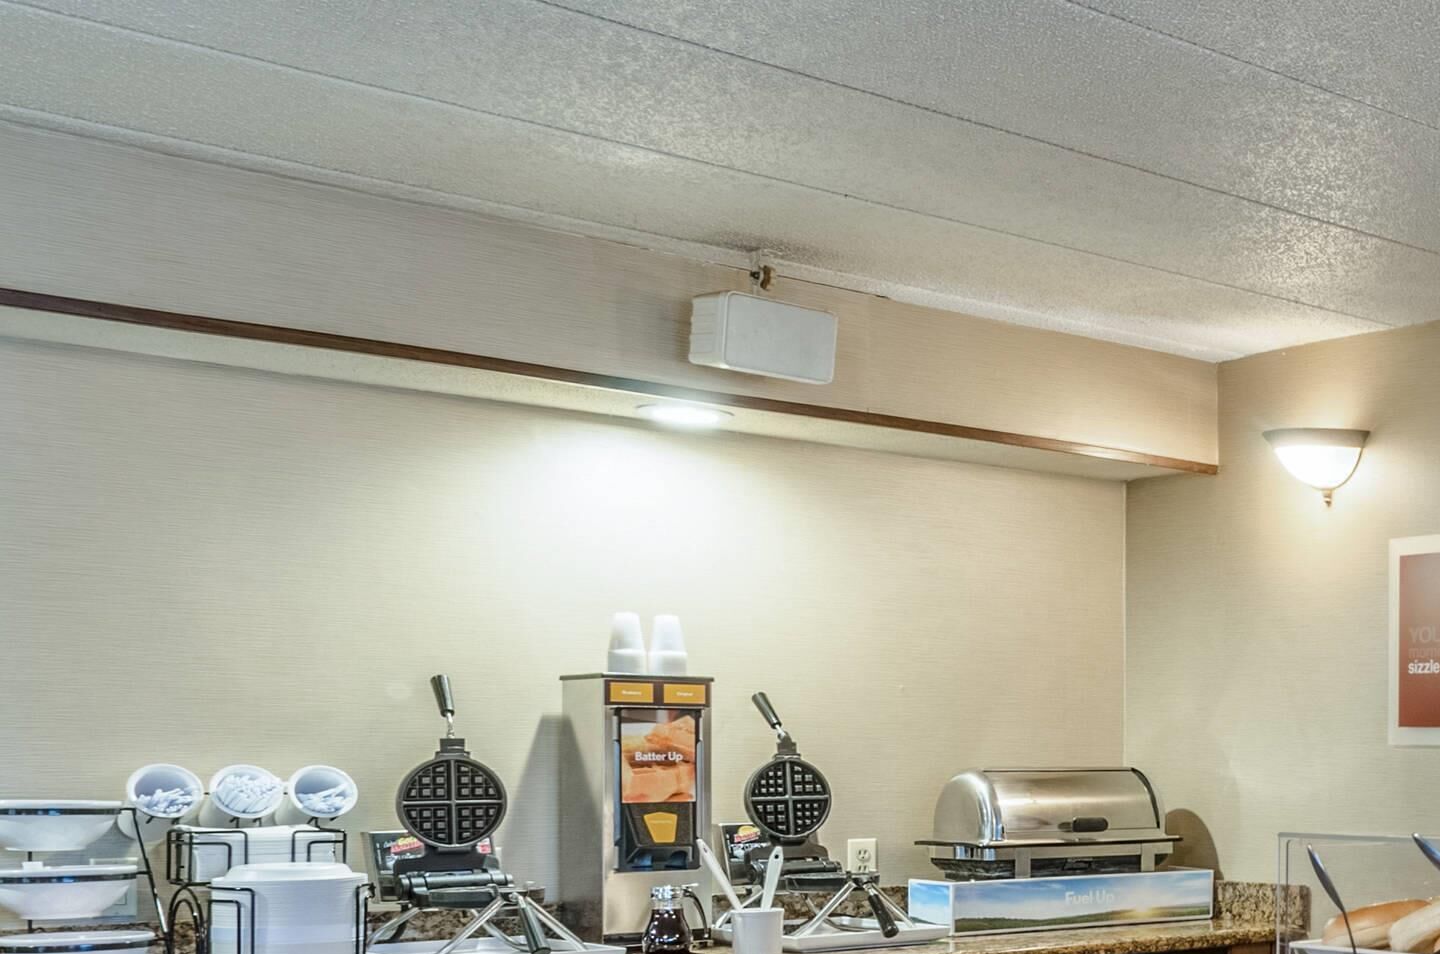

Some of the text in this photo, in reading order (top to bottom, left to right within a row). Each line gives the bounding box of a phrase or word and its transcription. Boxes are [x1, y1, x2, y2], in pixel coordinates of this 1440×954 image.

[1408, 659, 1440, 674] sizzle
[634, 751, 684, 763] Batter Up
[1065, 888, 1115, 911] Fuel Up
